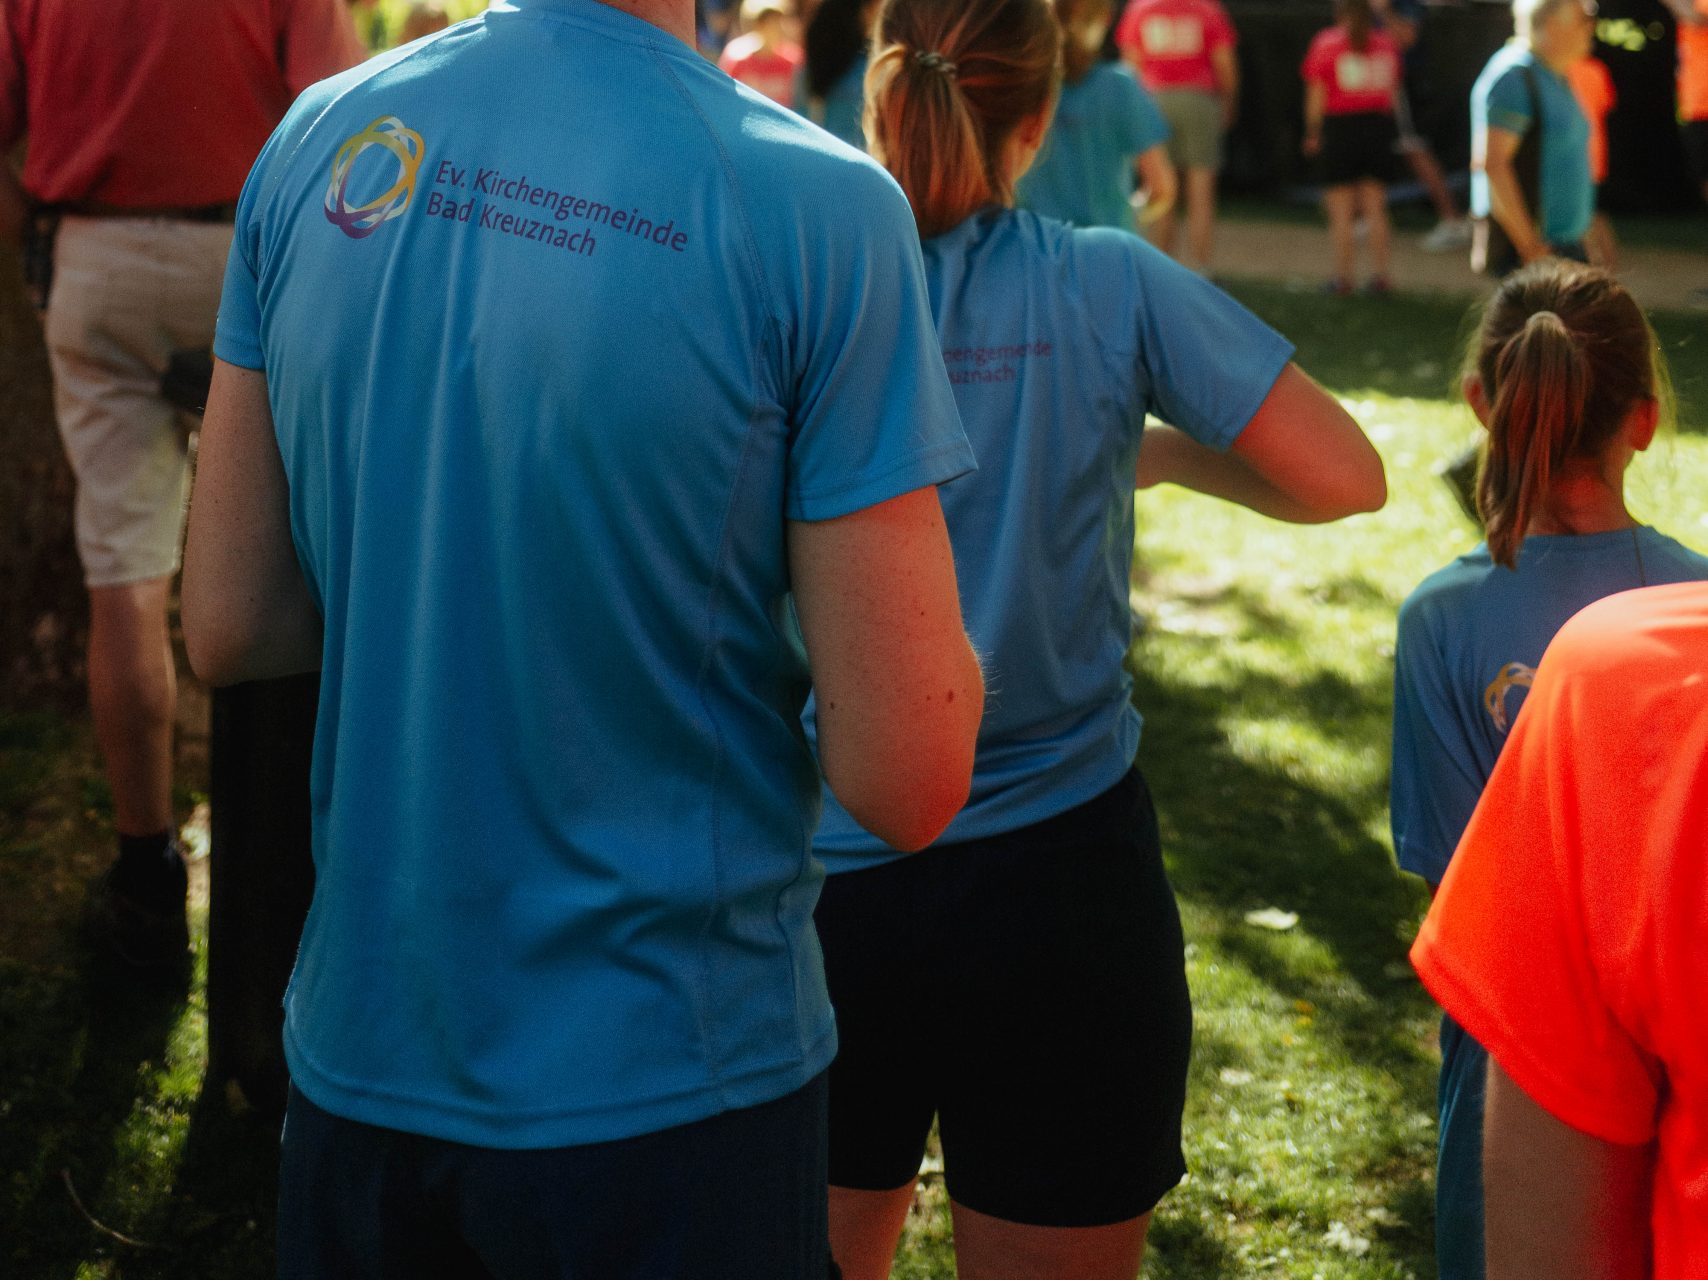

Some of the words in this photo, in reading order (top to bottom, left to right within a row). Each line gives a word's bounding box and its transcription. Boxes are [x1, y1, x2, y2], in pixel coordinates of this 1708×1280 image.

[426, 191, 476, 223] Bad
[479, 202, 597, 257] Kreuznach
[434, 160, 466, 188] Ev.
[473, 167, 689, 252] Kirchengemeinde
